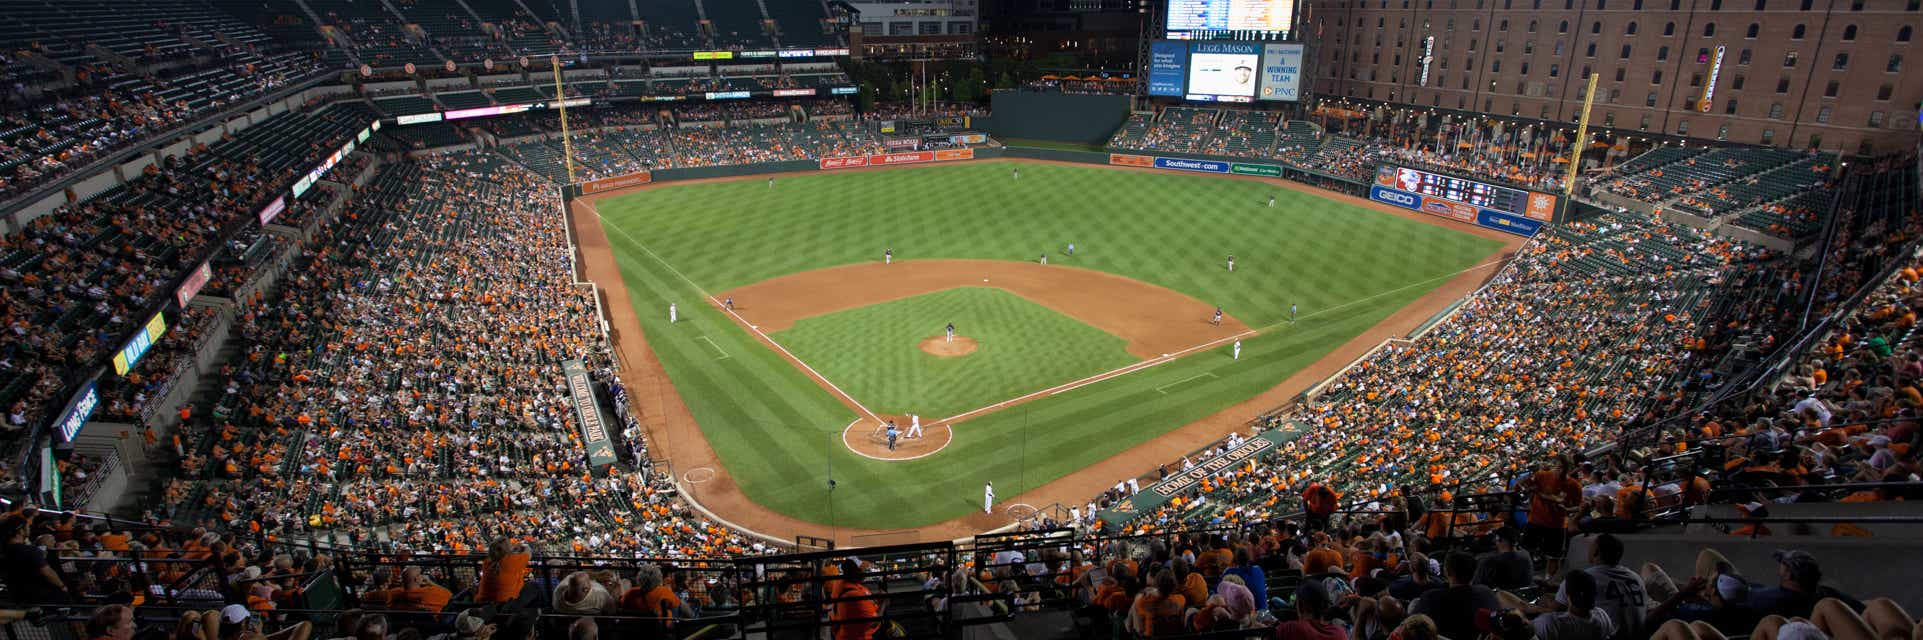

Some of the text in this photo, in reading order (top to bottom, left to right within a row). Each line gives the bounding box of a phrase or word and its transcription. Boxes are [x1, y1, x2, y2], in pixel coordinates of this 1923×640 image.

[1198, 43, 1254, 54] LEGG MASON
[1267, 66, 1297, 74] WINNING
[1275, 88, 1296, 96] PNC
[1379, 190, 1414, 205] GEICO
[62, 388, 97, 442] LONG FENCE
[1156, 438, 1270, 495] HOME OF THE ORIOLES
